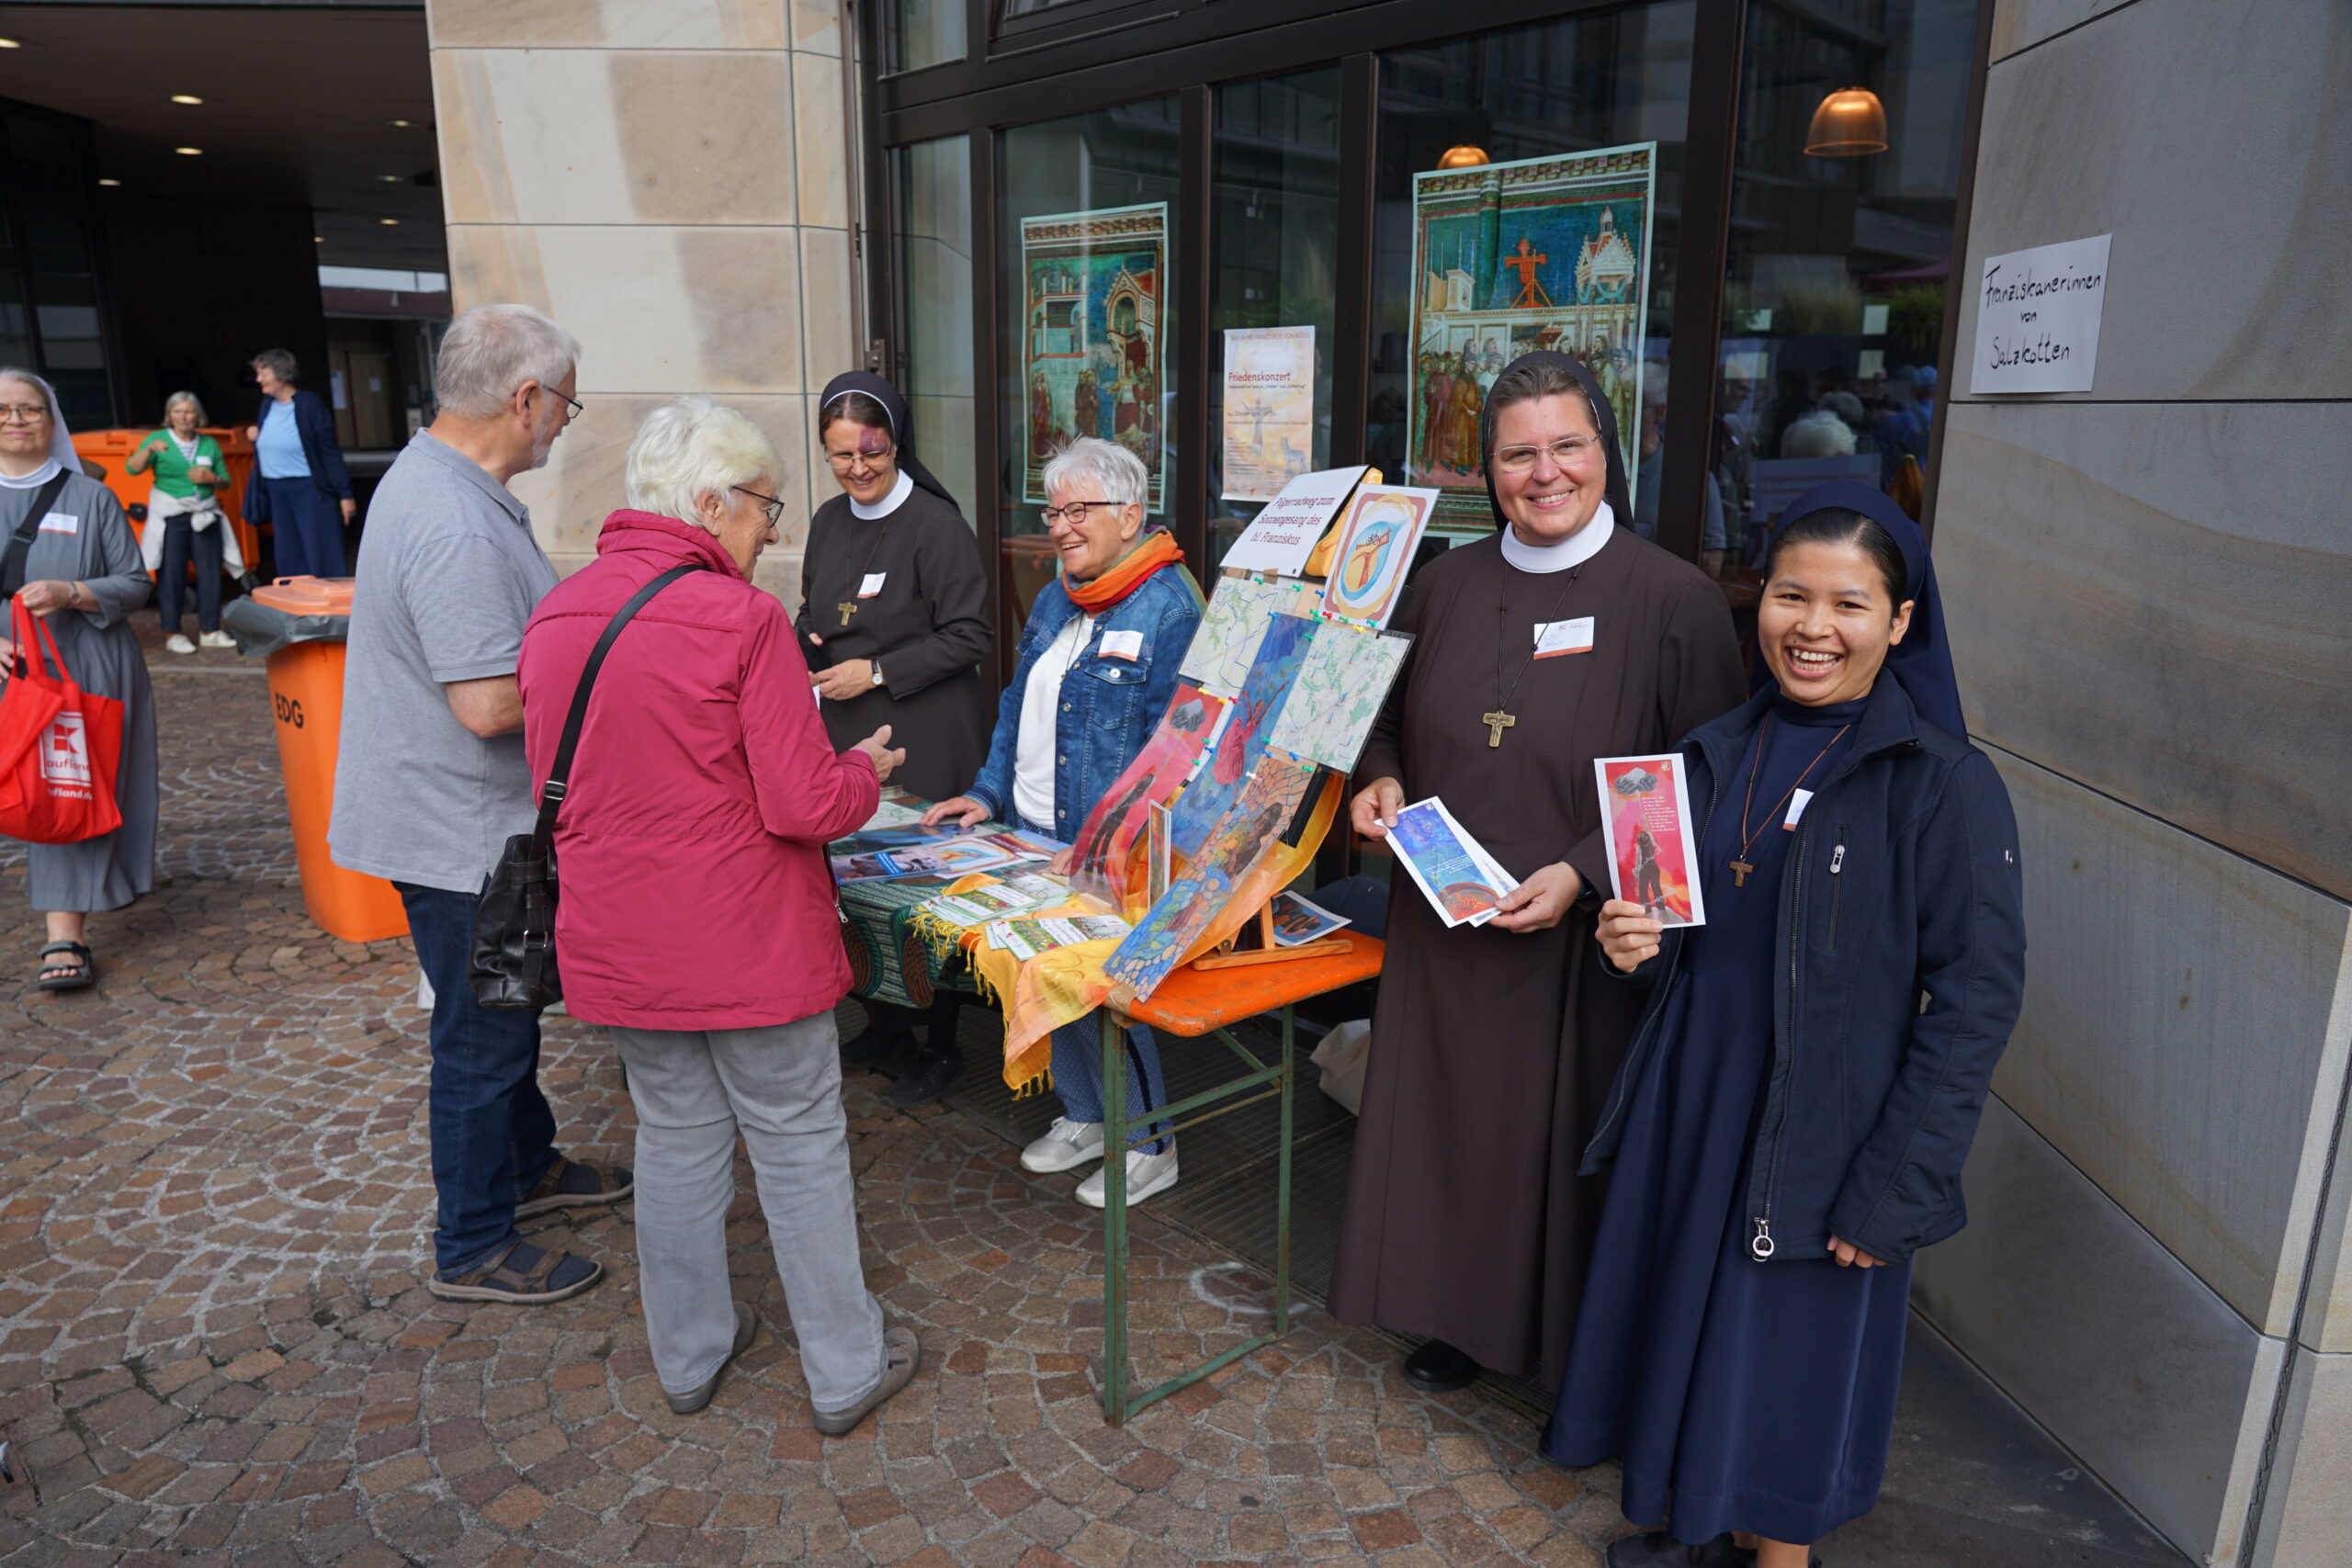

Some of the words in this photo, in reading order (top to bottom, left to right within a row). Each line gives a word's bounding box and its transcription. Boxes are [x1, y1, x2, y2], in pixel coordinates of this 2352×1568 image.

[1985, 265, 2101, 309] Franziskanerinnen
[2020, 310, 2038, 323] von
[1990, 332, 2070, 369] Salzkotten
[1227, 370, 1292, 382] Friedenskonzert
[1316, 497, 1335, 506] zum
[1258, 514, 1307, 528] Sonnengesang
[1306, 514, 1322, 525] des
[1260, 532, 1302, 546] Franziskus
[275, 692, 304, 729] EDG
